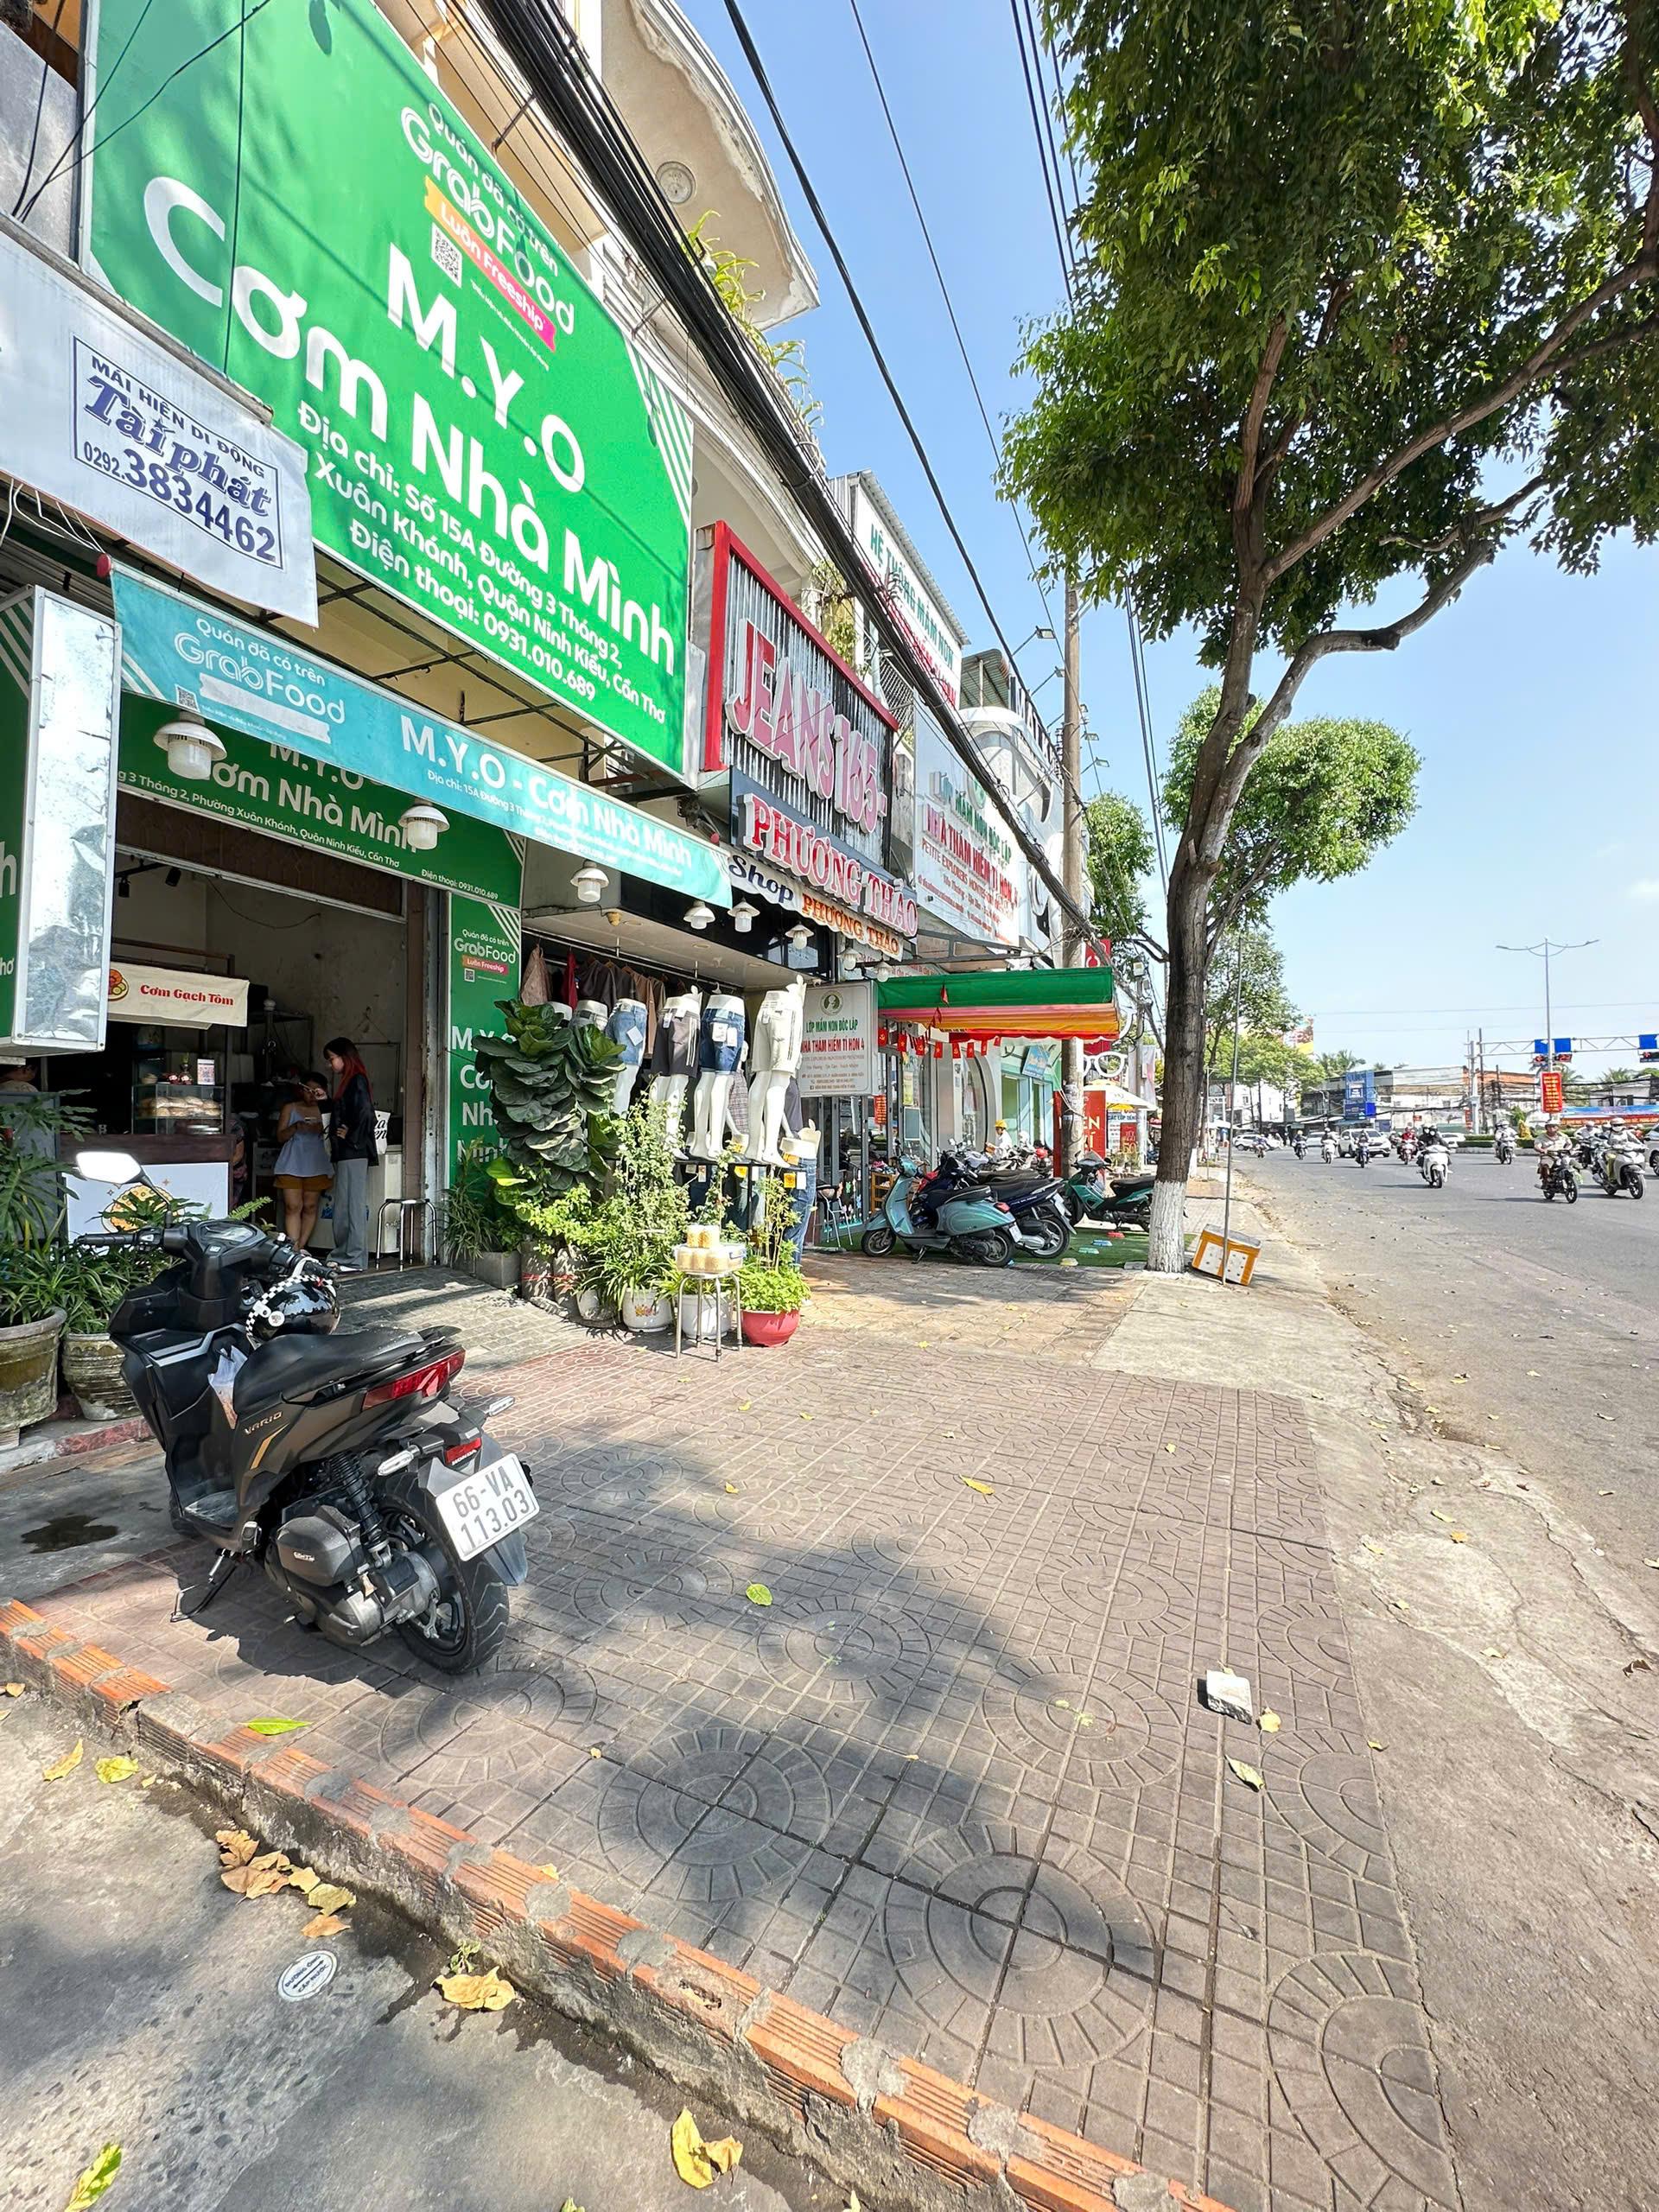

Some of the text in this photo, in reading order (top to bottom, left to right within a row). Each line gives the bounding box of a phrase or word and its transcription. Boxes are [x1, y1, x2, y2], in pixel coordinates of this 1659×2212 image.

[401, 106, 575, 335] GrabFood
[429, 103, 479, 176] Quán
[482, 172, 504, 208] đã
[528, 228, 559, 276] trên
[441, 201, 481, 257] Luôn
[483, 252, 544, 331] Freeship
[387, 242, 585, 493] M.Y.O
[91, 355, 264, 479] MÁI HIÊN DI ĐỘNG
[143, 176, 387, 442] Cơm
[412, 391, 549, 574] Nhà
[564, 527, 674, 677] Mình
[297, 400, 623, 670] Địa chỉ: Số 15A Đường 3 Tháng 2,
[314, 452, 388, 524] Xuân
[393, 516, 474, 589] Khánh,
[477, 573, 531, 626] Quận
[533, 614, 572, 658] Ninh
[640, 692, 666, 724] Thơ
[349, 518, 596, 702] Điện thoại: 0931.010.689
[174, 632, 346, 724] GrabFood
[195, 618, 326, 687] Quán đã có trên
[725, 617, 836, 800] JEANS
[129, 772, 137, 782] 3
[139, 772, 179, 800] Tháng
[180, 788, 190, 802] 2,
[192, 792, 235, 817] Phường
[235, 805, 264, 825] Xuân
[264, 814, 298, 836] Khánh,
[299, 828, 325, 846] Quận
[326, 836, 346, 851] Ninh
[384, 852, 400, 868] Thơ
[204, 760, 270, 802] ơm
[278, 779, 343, 827] Nhà
[400, 715, 506, 790] M.Y.O
[593, 800, 640, 847] Nhà
[644, 823, 692, 868] Mình
[458, 880, 499, 901] 0931.010.689
[728, 855, 794, 904] Shop
[743, 792, 863, 906] PHƯƠNG
[863, 869, 918, 938] THẢO
[454, 938, 517, 964] GrabFood
[461, 928, 480, 939] Quán
[801, 892, 899, 955] PHƯƠNG THẢO
[140, 983, 234, 1007] Cơm Gạch Tôm
[461, 1101, 499, 1126] Nh
[245, 1410, 283, 1435] VARIO
[451, 1448, 477, 1465] HONDA
[452, 1465, 515, 1519] 66-VA
[461, 1490, 531, 1551] 113.03
